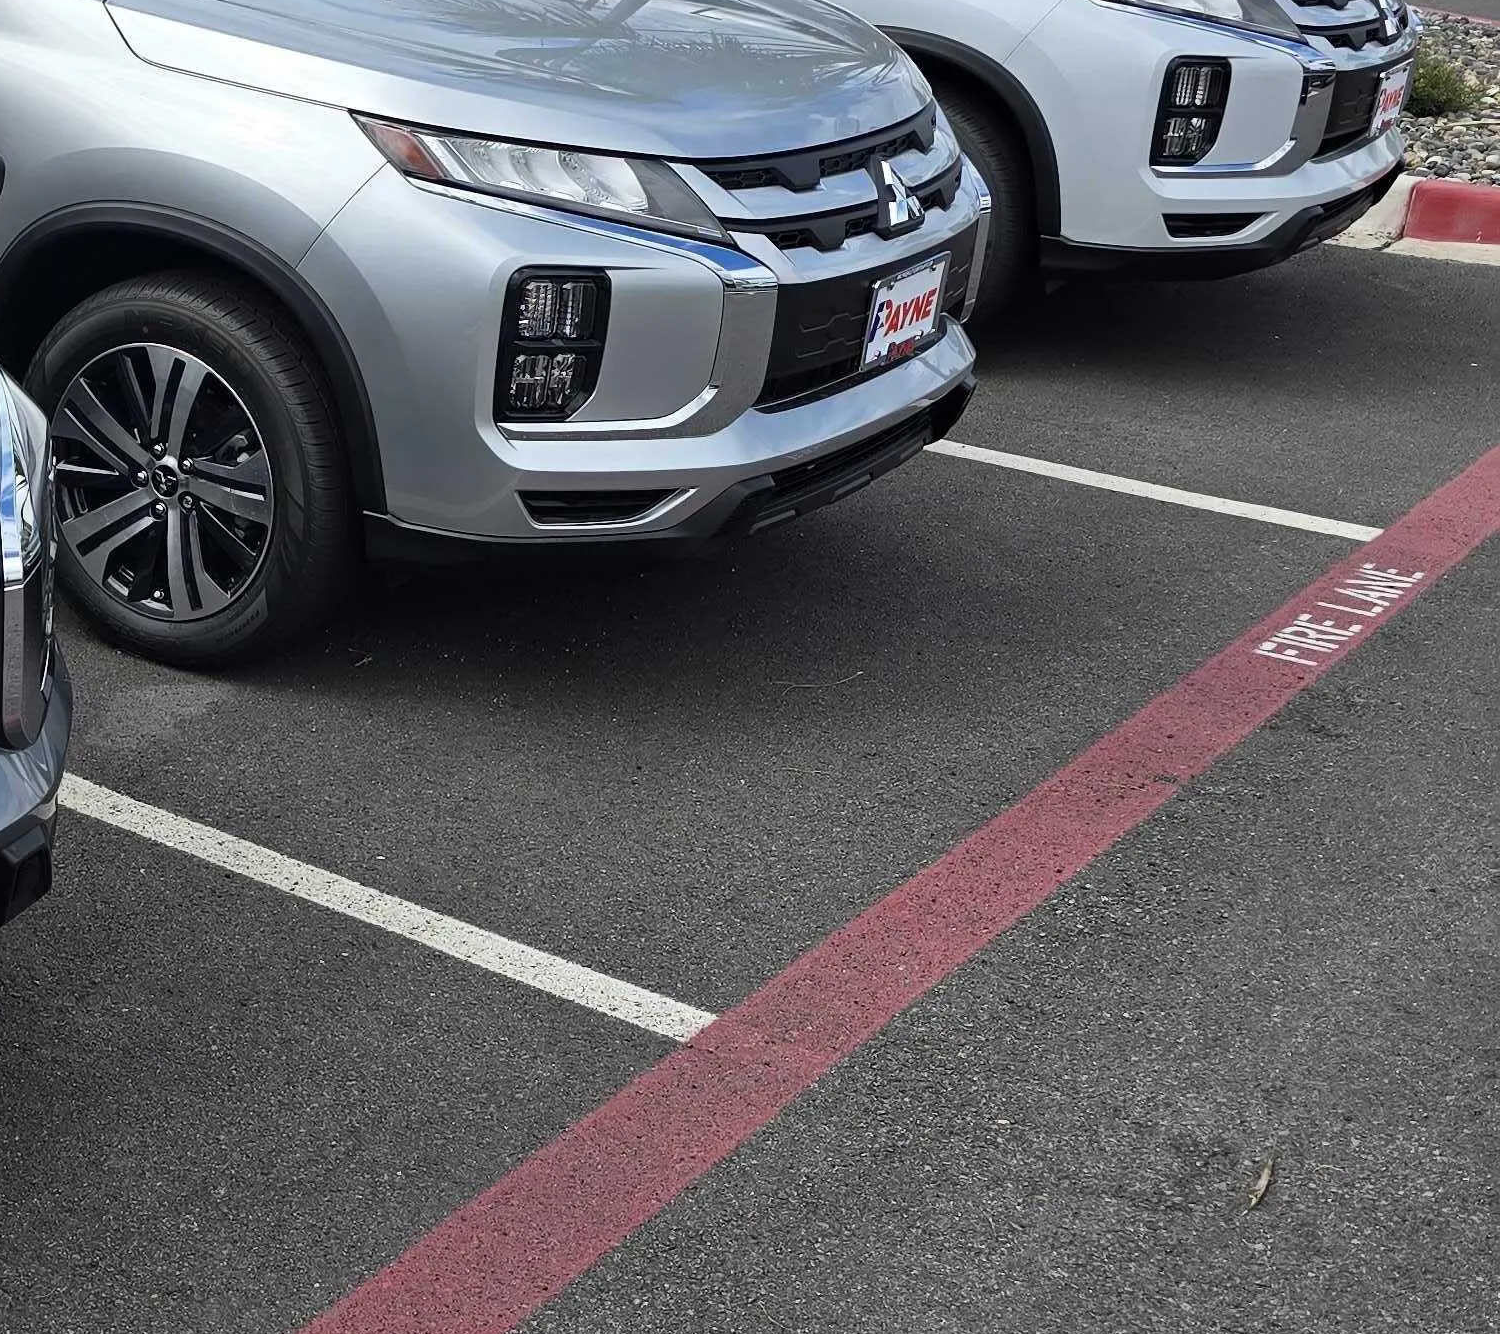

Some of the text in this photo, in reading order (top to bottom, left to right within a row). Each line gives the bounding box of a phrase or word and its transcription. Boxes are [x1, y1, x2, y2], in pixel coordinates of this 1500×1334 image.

[868, 287, 938, 342] PAYNE
[1253, 562, 1424, 666] FIRE LANE
